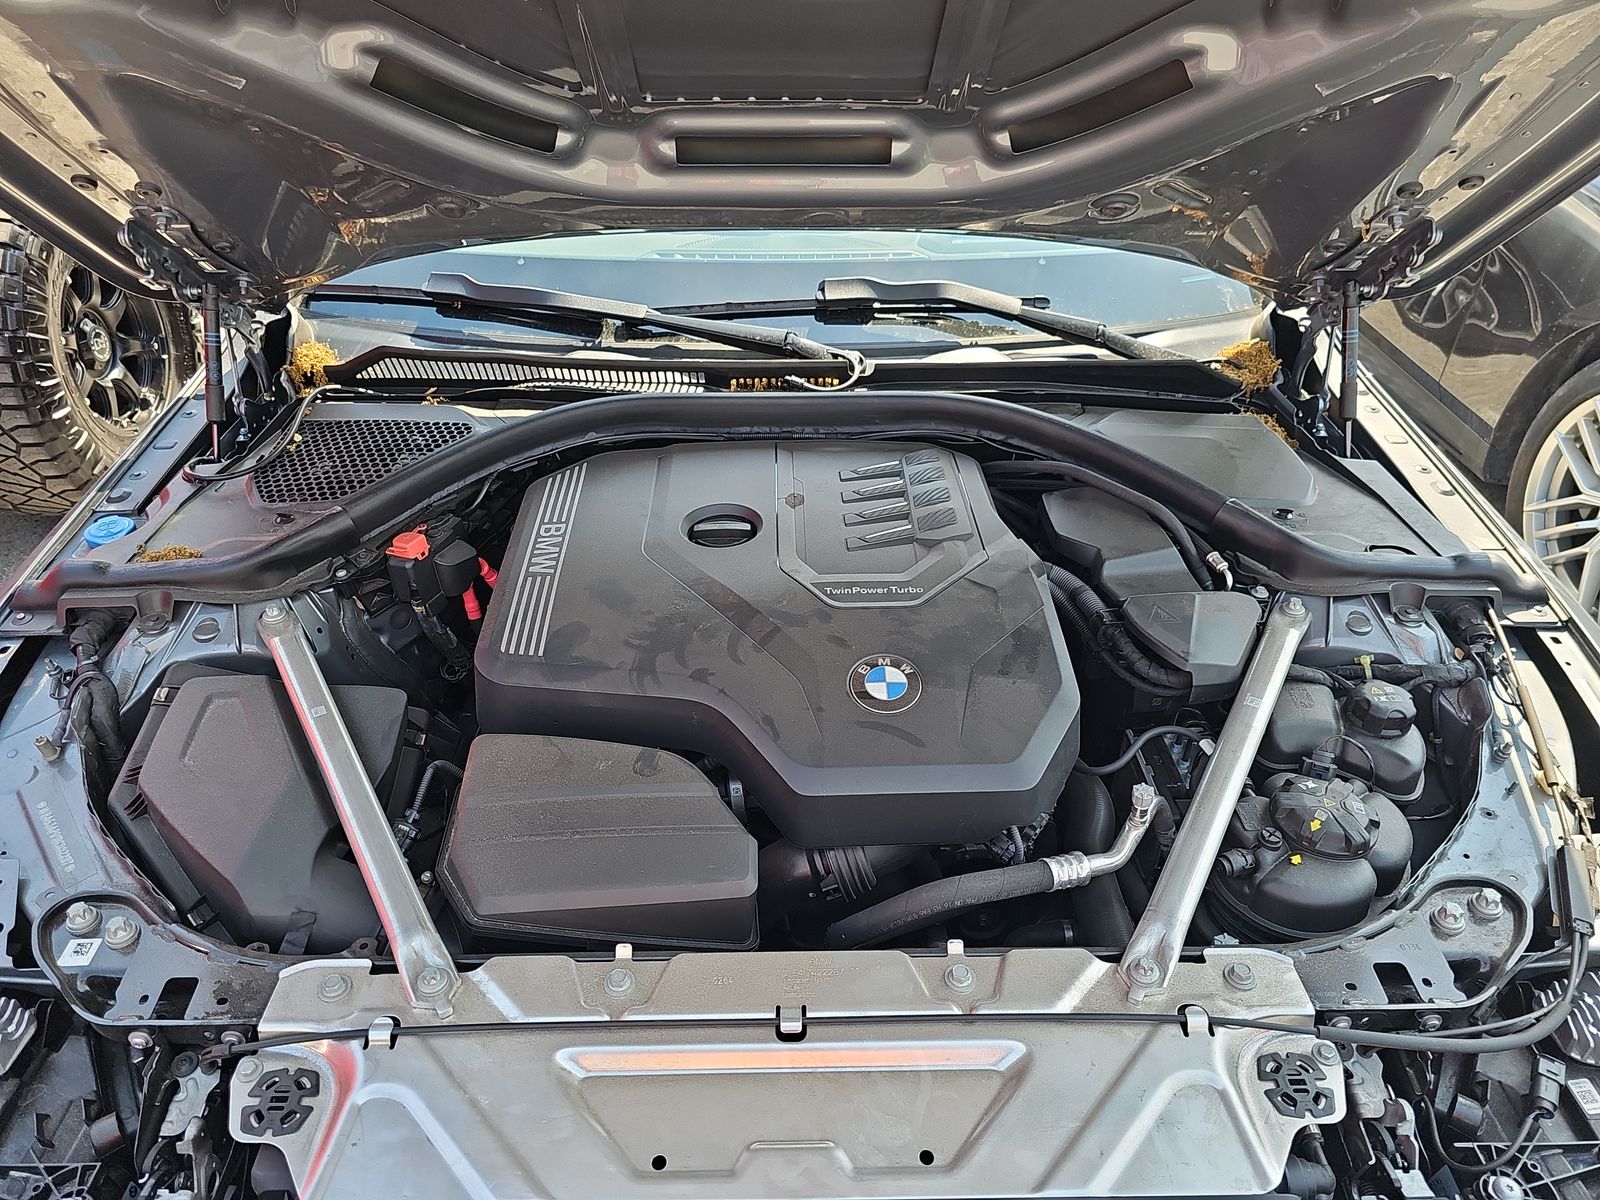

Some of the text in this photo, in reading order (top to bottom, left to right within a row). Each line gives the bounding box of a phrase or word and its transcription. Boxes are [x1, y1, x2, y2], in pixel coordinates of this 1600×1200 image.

[528, 523, 567, 574] BMW
[824, 585, 924, 595] TwinPower Turbo
[857, 657, 915, 675] BMW
